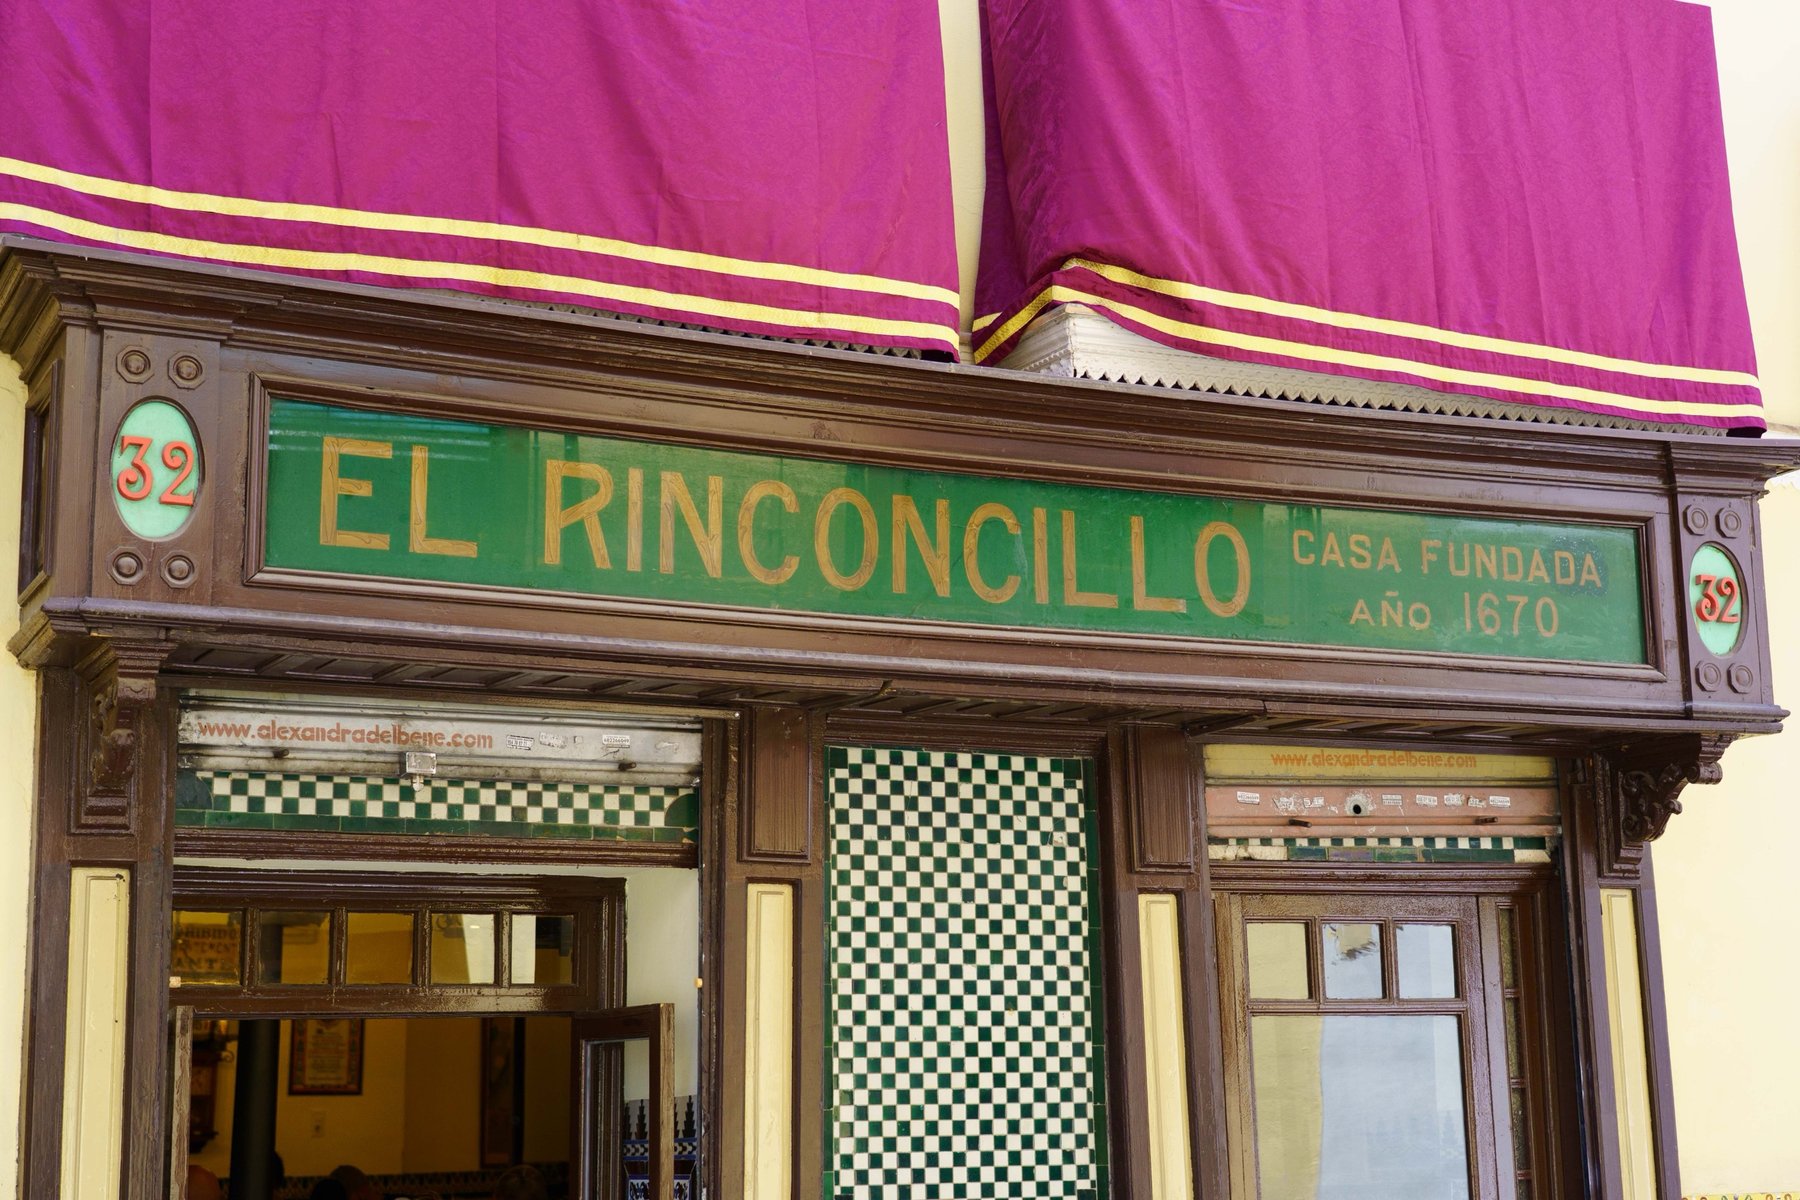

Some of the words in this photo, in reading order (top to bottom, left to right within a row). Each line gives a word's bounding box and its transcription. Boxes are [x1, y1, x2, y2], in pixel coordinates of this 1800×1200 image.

[116, 435, 195, 507] 32
[319, 436, 478, 558] EL
[543, 459, 1251, 618] RINCONCILLO
[1293, 529, 1401, 573] CASA
[1420, 539, 1602, 588] FUNDADA
[1349, 591, 1431, 631] AÑO
[1464, 592, 1560, 638] 1670
[1695, 574, 1739, 623] 32
[198, 719, 494, 749] www.alexandradelbene.com
[1270, 750, 1477, 769] www.alexandradelbene.com
